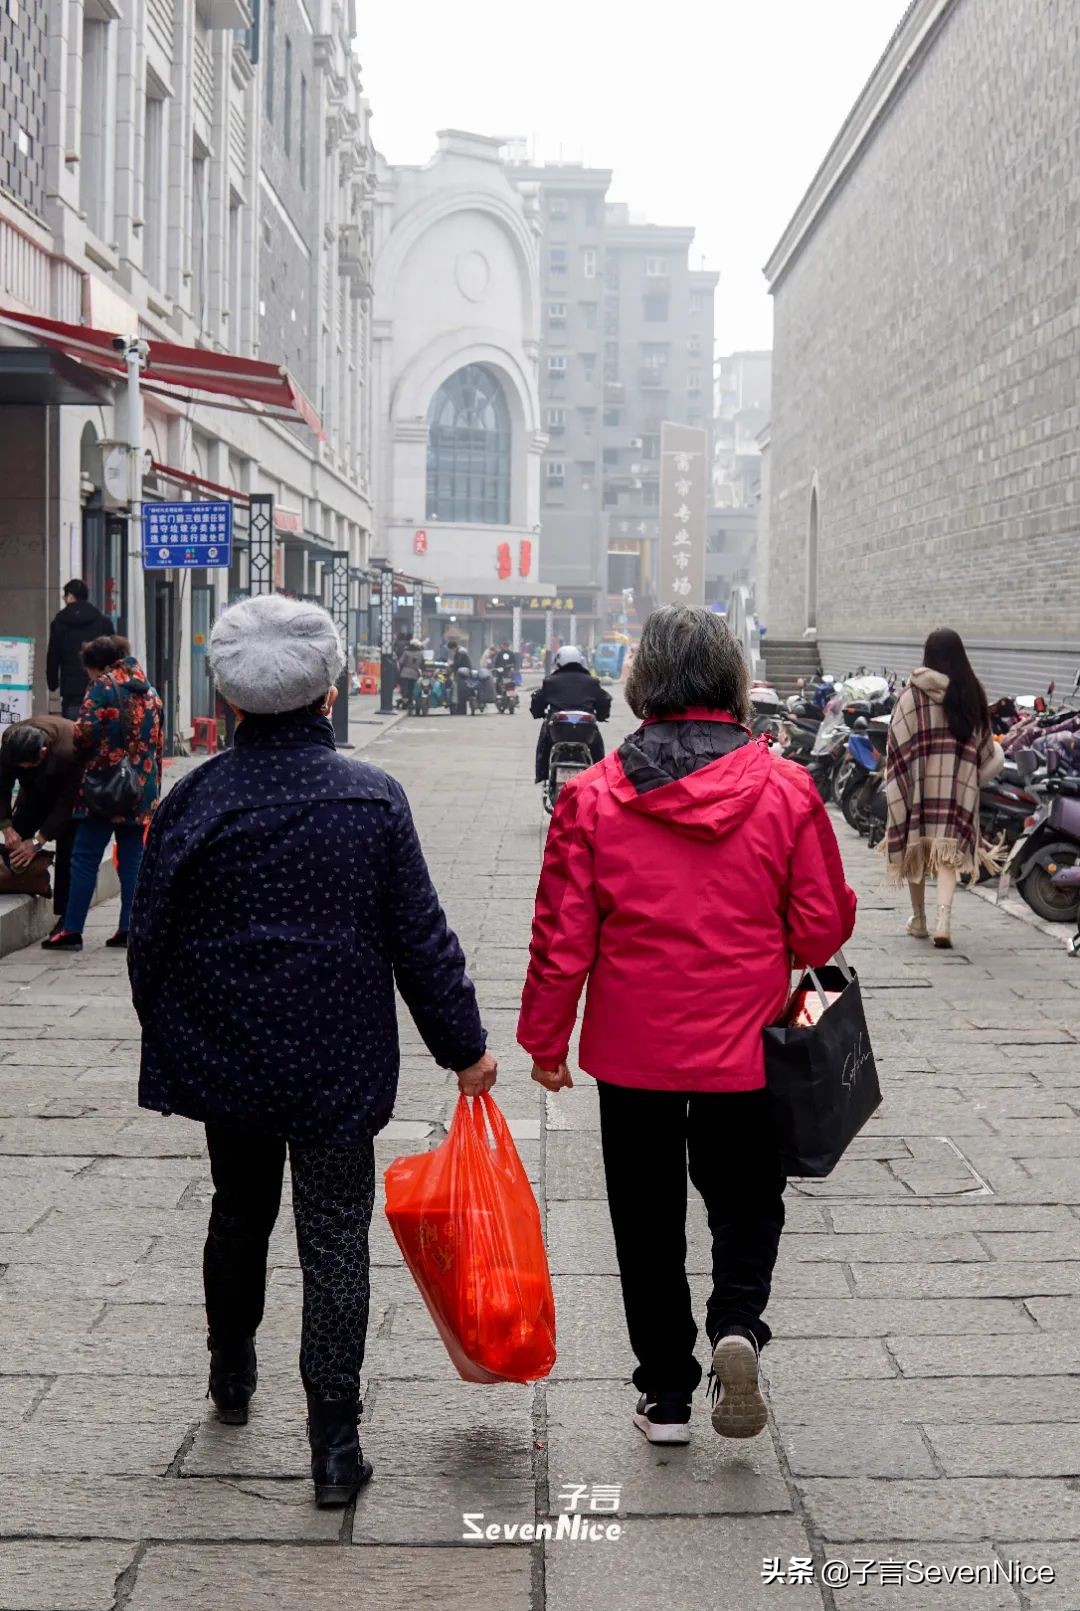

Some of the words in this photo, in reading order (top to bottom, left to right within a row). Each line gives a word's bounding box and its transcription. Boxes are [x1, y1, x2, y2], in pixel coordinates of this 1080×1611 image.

[150, 514, 225, 523] 落实门前三包责任制
[150, 524, 225, 533] 遵守垃圾分类条例
[150, 533, 225, 543] 违者依法行政处罚
